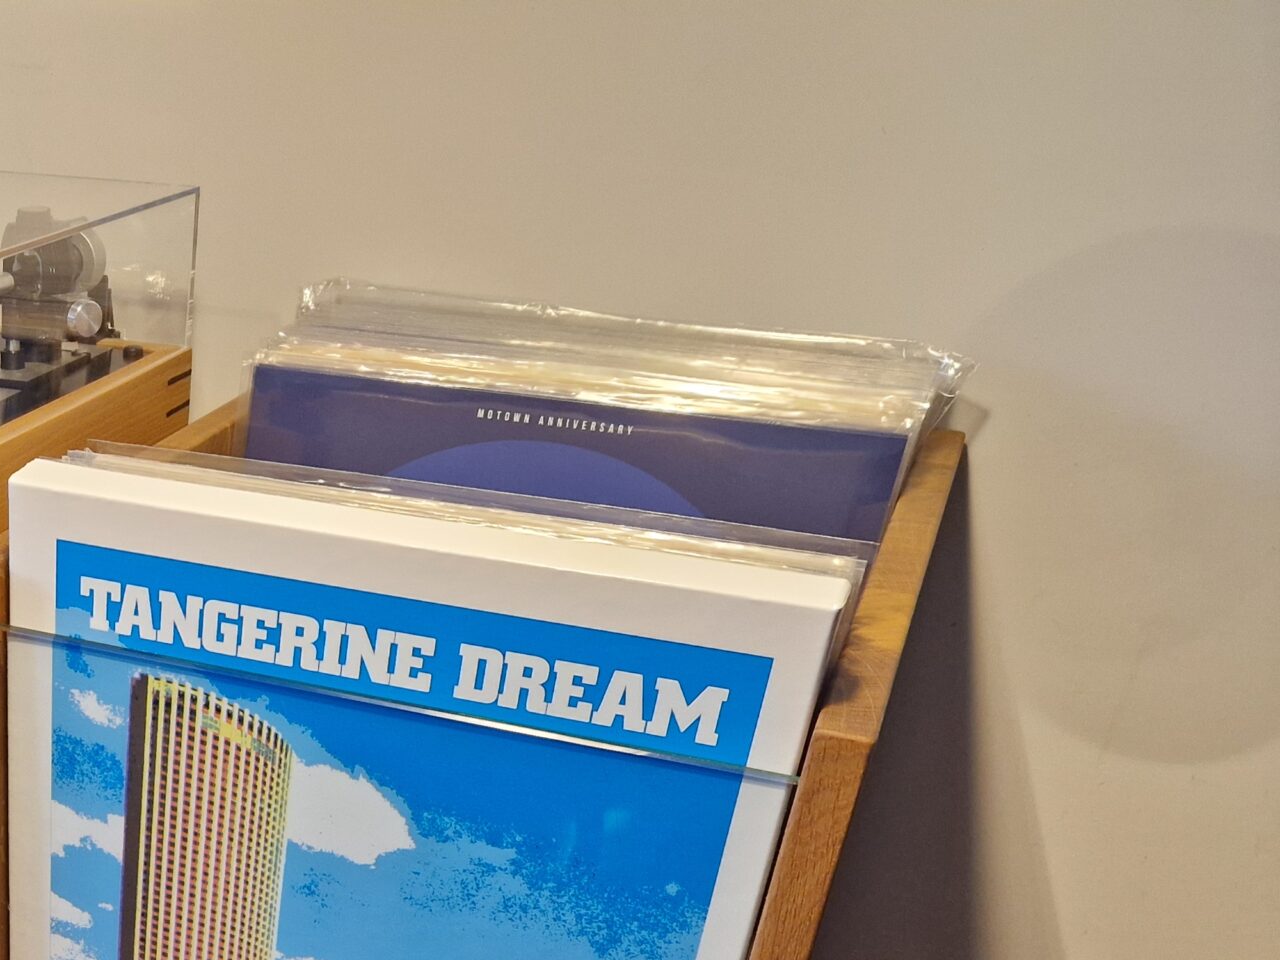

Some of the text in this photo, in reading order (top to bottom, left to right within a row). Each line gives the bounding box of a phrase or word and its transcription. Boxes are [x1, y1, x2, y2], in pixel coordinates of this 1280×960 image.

[476, 408, 634, 436] MOTOWN ANNIVERSARY
[79, 575, 730, 747] TANGERINE DREAM
